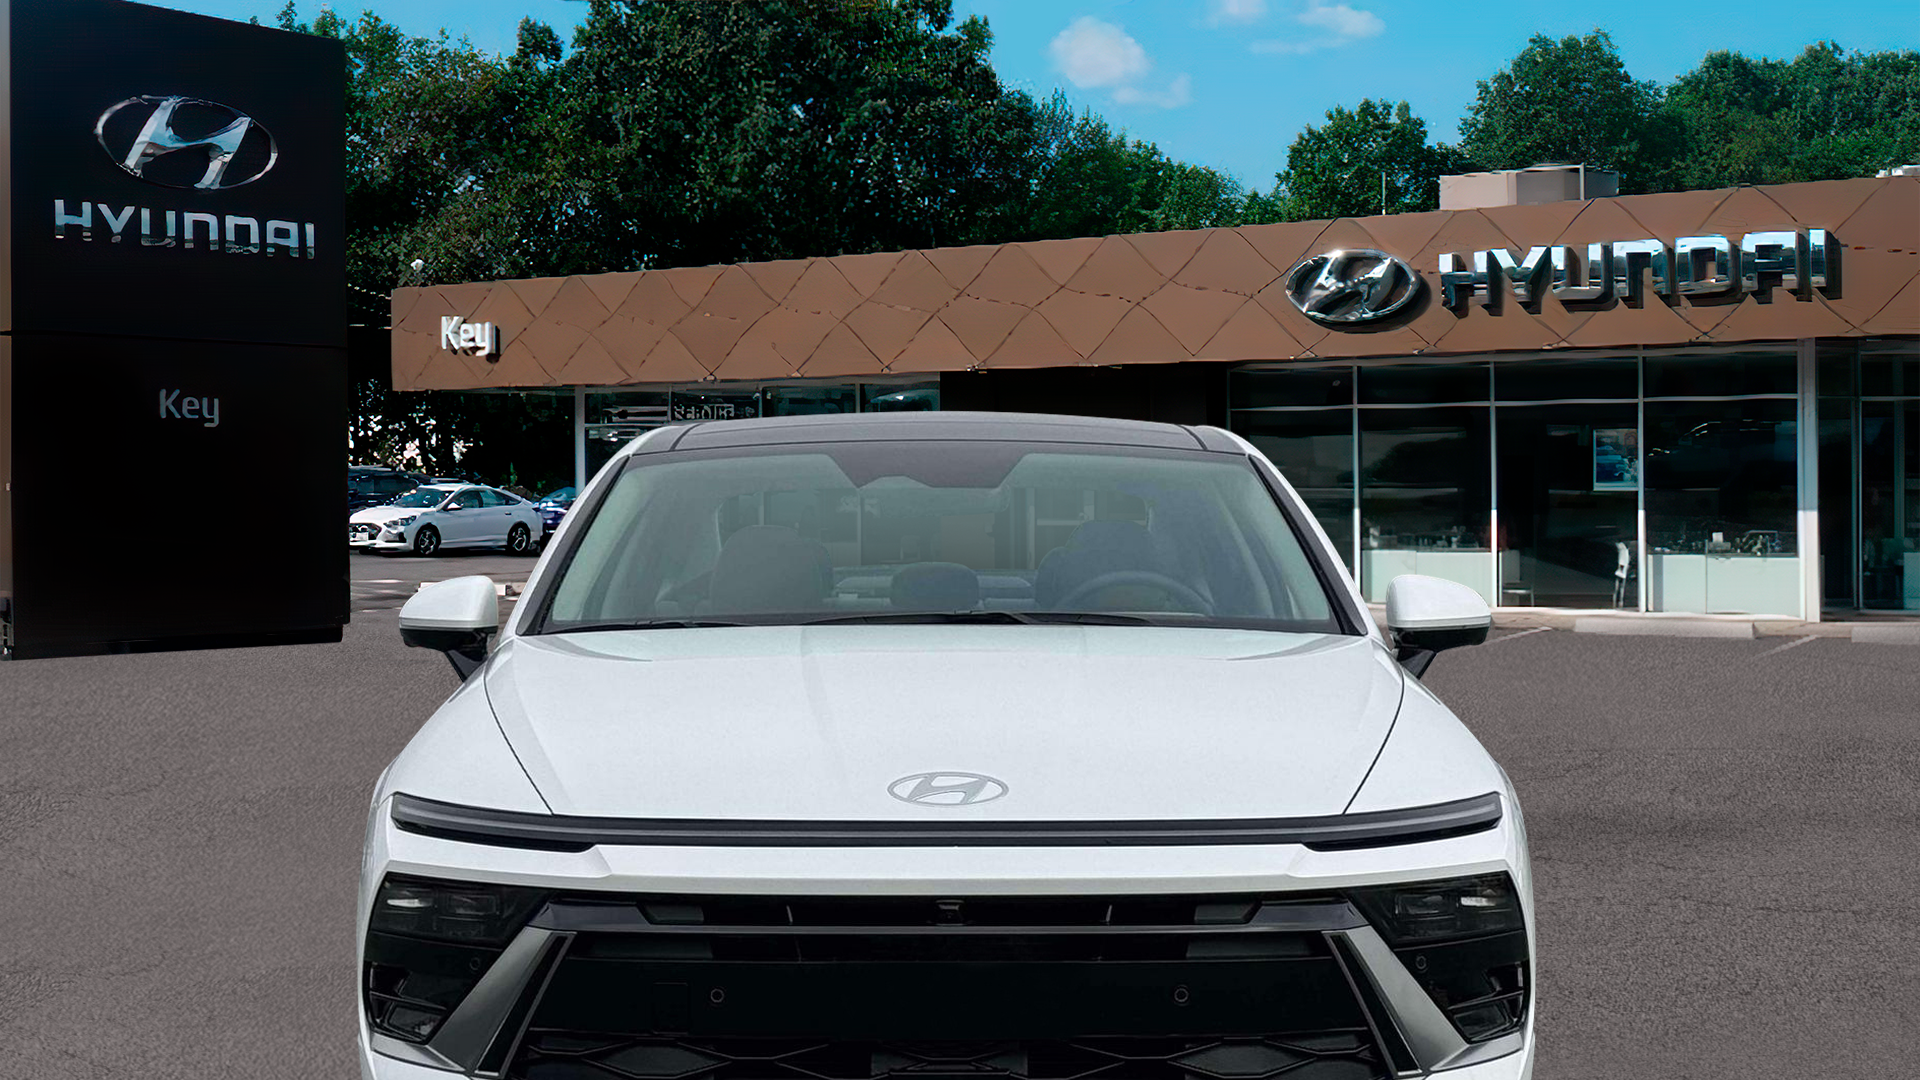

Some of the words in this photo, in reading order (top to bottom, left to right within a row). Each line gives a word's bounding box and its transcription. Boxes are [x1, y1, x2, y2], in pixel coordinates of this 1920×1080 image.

[54, 199, 315, 259] HYUNDAI
[1438, 229, 1842, 316] HYUNDAI
[440, 315, 493, 357] Key
[159, 388, 220, 428] Key
